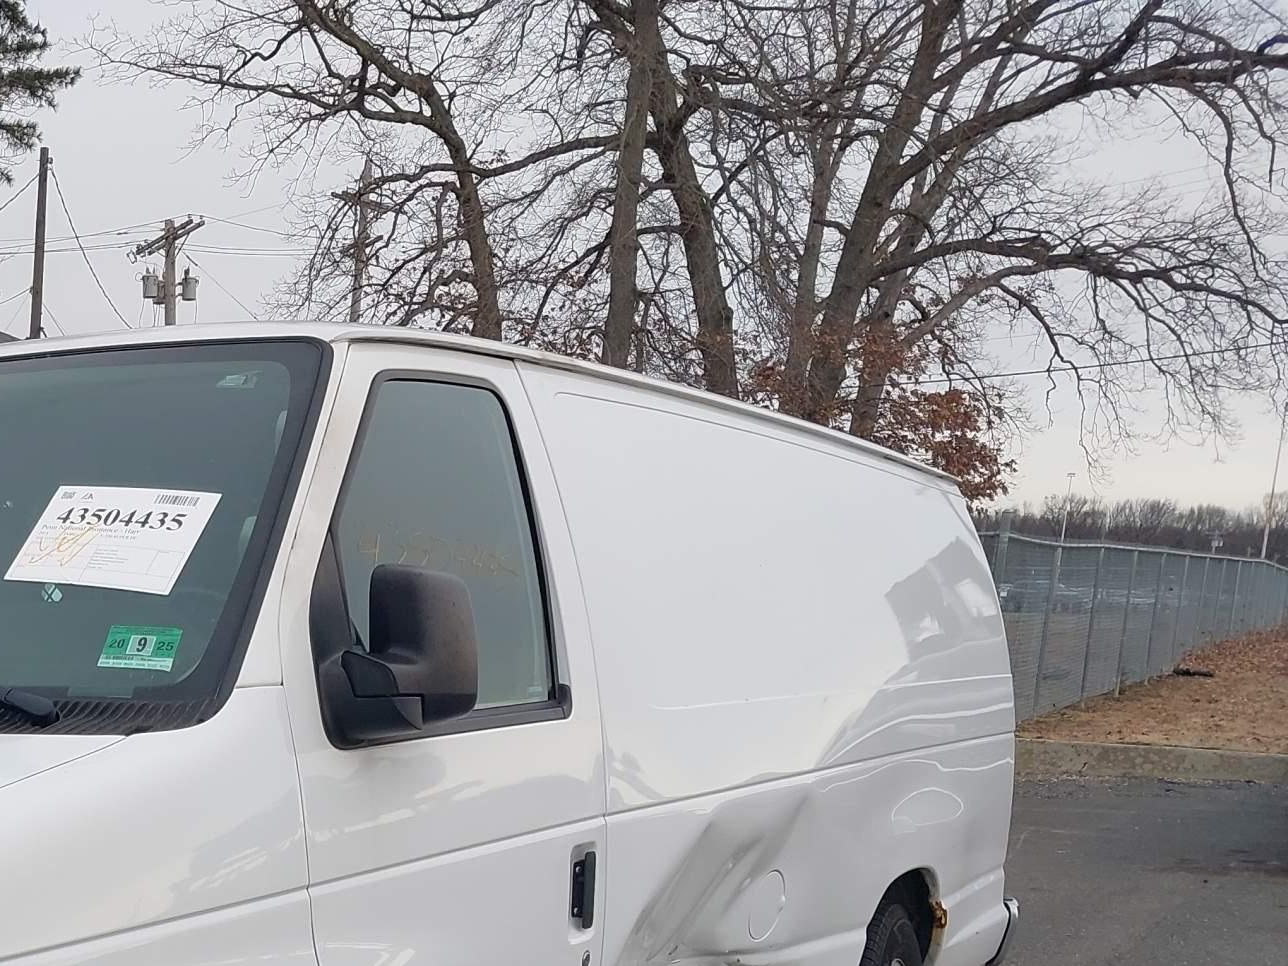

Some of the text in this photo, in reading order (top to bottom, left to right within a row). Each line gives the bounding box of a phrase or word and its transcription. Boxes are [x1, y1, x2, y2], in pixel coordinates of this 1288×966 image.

[56, 507, 188, 531] 43504435
[108, 636, 175, 653] 20 9 25
